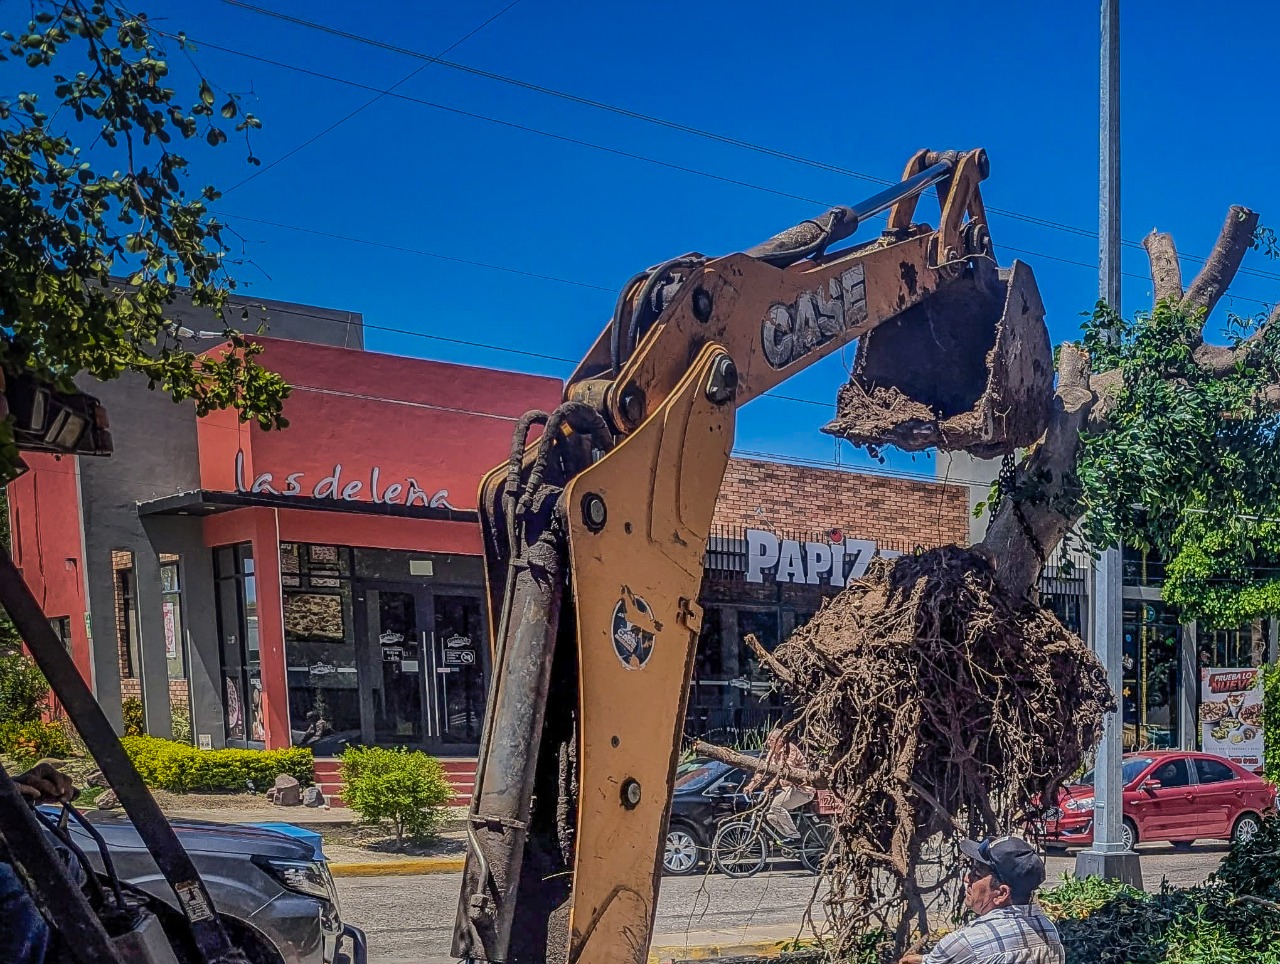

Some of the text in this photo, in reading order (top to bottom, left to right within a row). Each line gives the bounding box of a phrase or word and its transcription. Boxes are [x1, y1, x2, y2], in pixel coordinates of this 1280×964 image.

[761, 261, 868, 369] CASE
[235, 450, 455, 510] las de leña
[1214, 672, 1253, 682] PRUEBA LO
